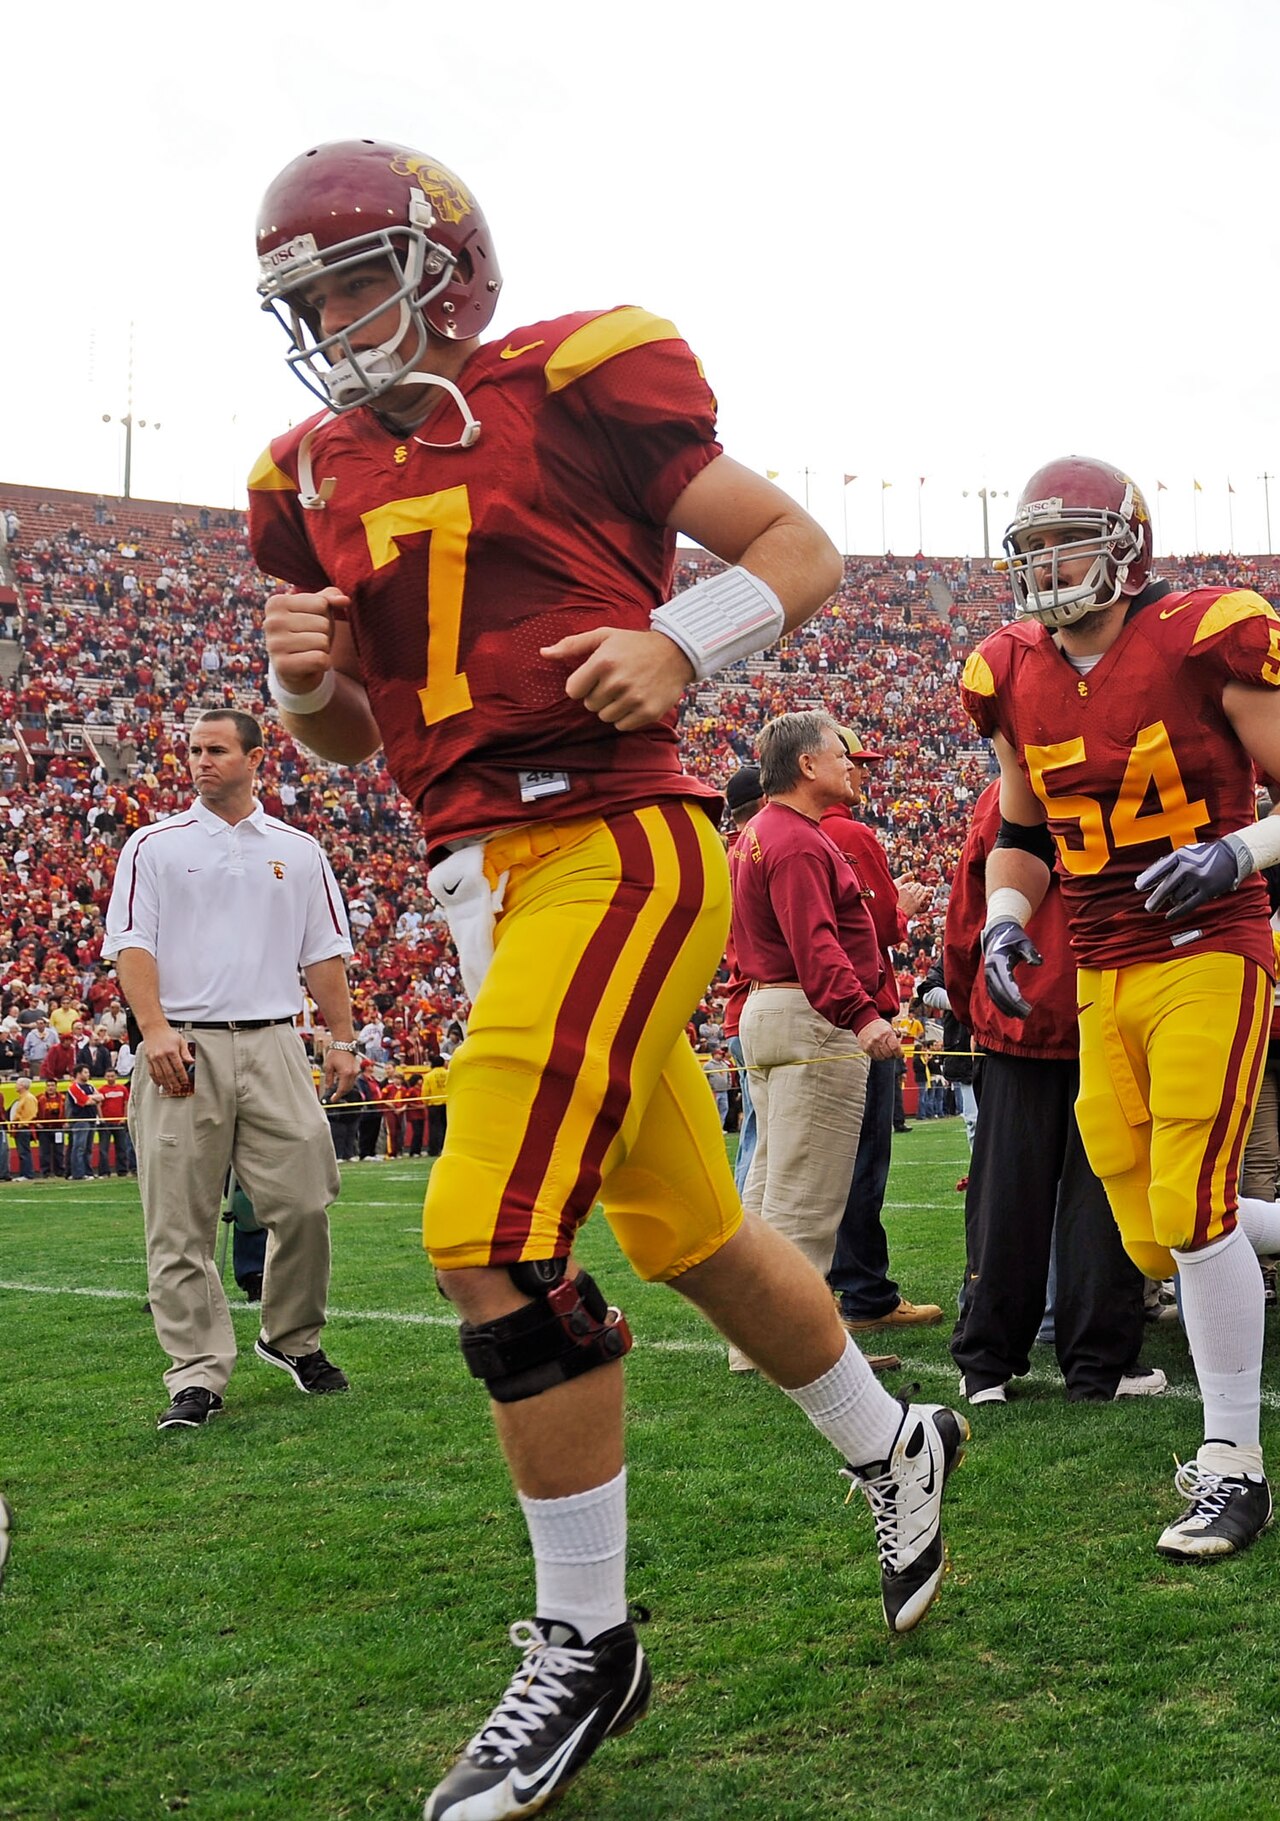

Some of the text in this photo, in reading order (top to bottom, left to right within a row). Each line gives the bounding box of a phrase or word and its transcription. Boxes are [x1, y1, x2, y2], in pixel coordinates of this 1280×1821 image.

[270, 245, 296, 266] USC
[1027, 502, 1050, 513] USC
[360, 484, 474, 726] 7
[1024, 720, 1212, 876] 54
